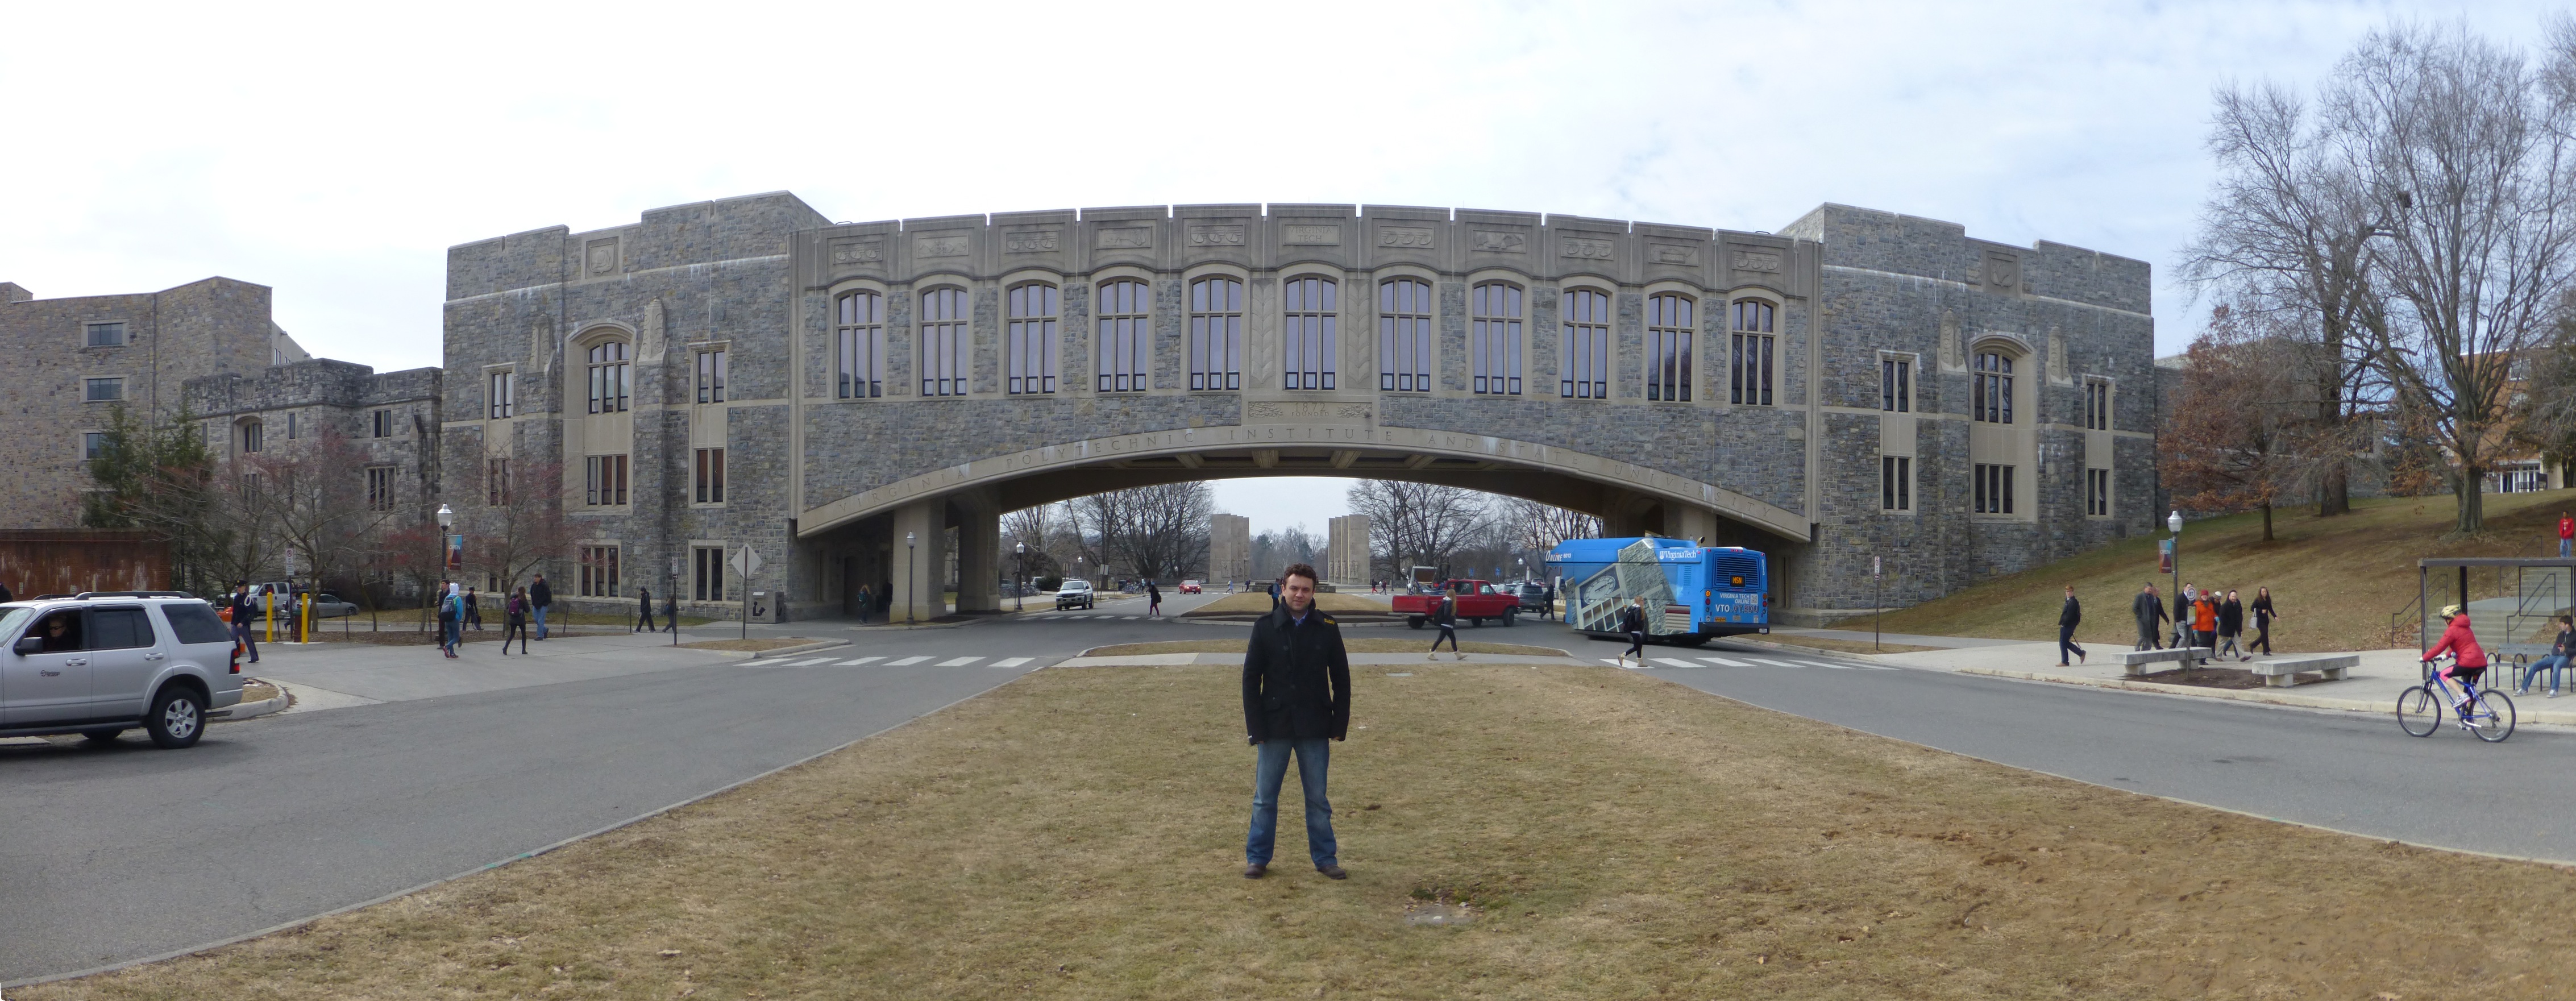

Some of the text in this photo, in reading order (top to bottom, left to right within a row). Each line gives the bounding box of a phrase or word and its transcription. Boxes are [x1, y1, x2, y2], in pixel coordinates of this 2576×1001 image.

[1295, 402, 1326, 412] 1872
[838, 427, 1771, 517] VIRGINIA POLYTECHNIC INSTITUTE AND STATE UNIVERSITY
[1715, 604, 1759, 613] VTO.VT.EDU
